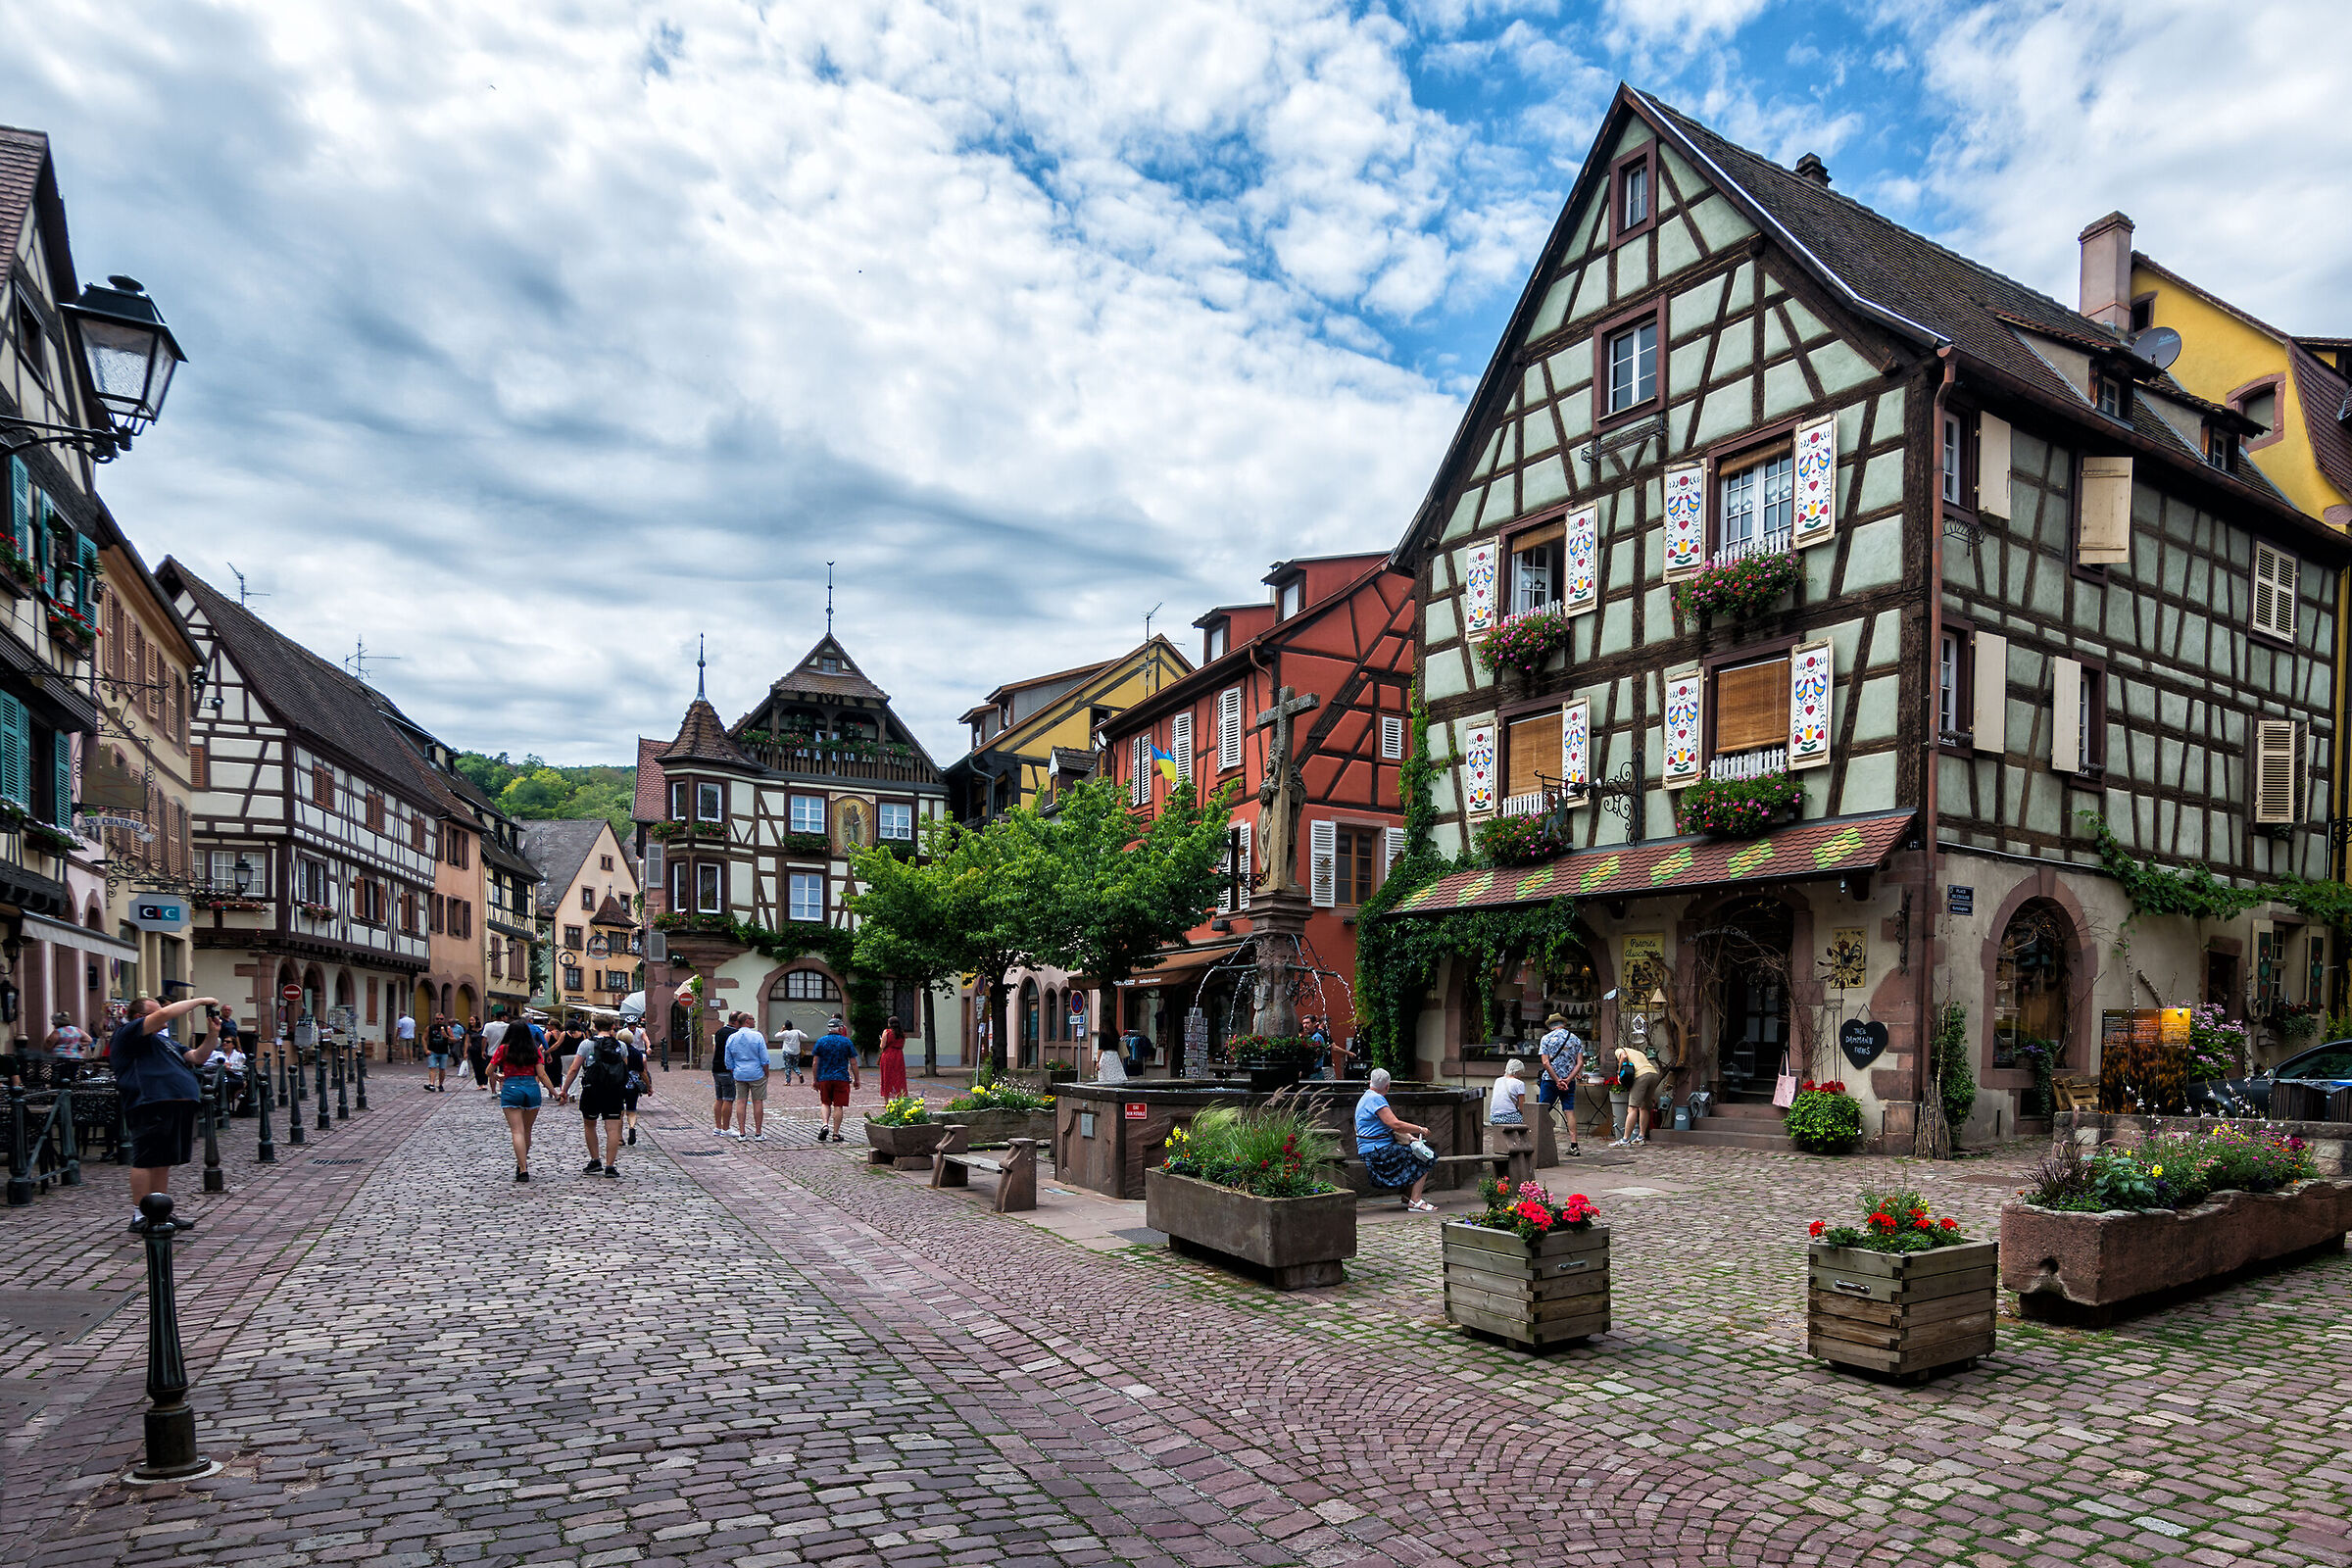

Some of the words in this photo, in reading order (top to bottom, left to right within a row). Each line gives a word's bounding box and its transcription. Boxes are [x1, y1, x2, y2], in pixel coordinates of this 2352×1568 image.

[102, 817, 143, 831] CHATEAU
[142, 907, 176, 918] CIC
[1844, 1035, 1874, 1045] DAMMANN
